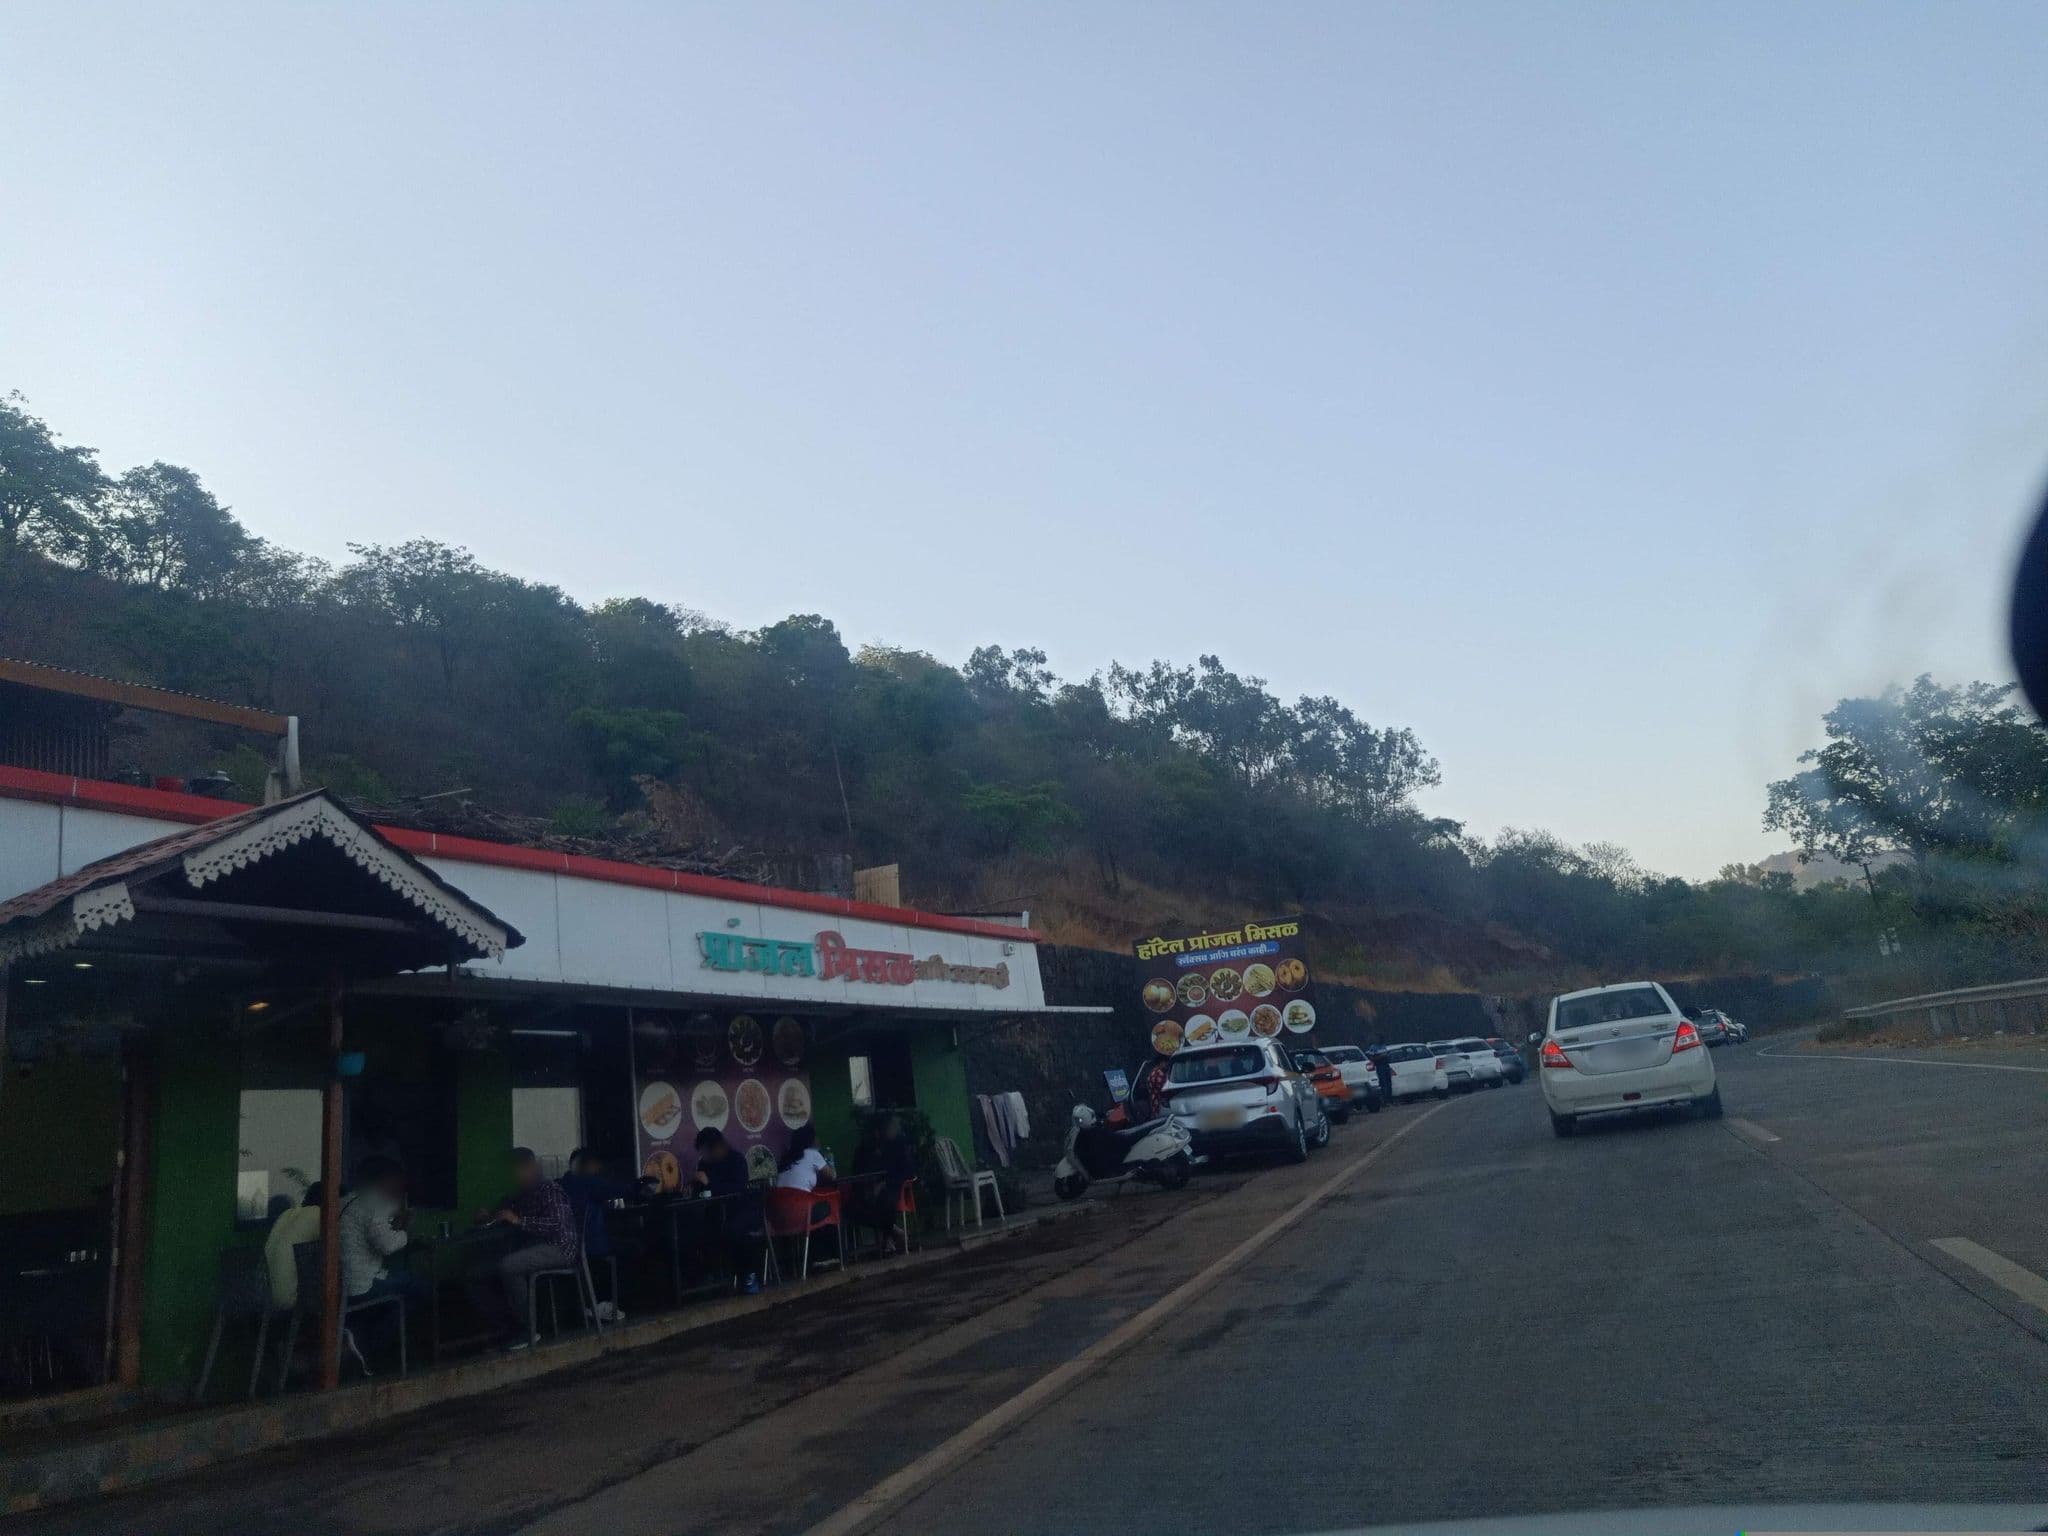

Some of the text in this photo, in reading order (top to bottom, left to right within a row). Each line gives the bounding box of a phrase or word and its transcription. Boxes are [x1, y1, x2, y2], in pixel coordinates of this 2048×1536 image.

[816, 930, 914, 985] मिसळ
[1136, 922, 1299, 960] हॉटेल प्रांजल मिसळ
